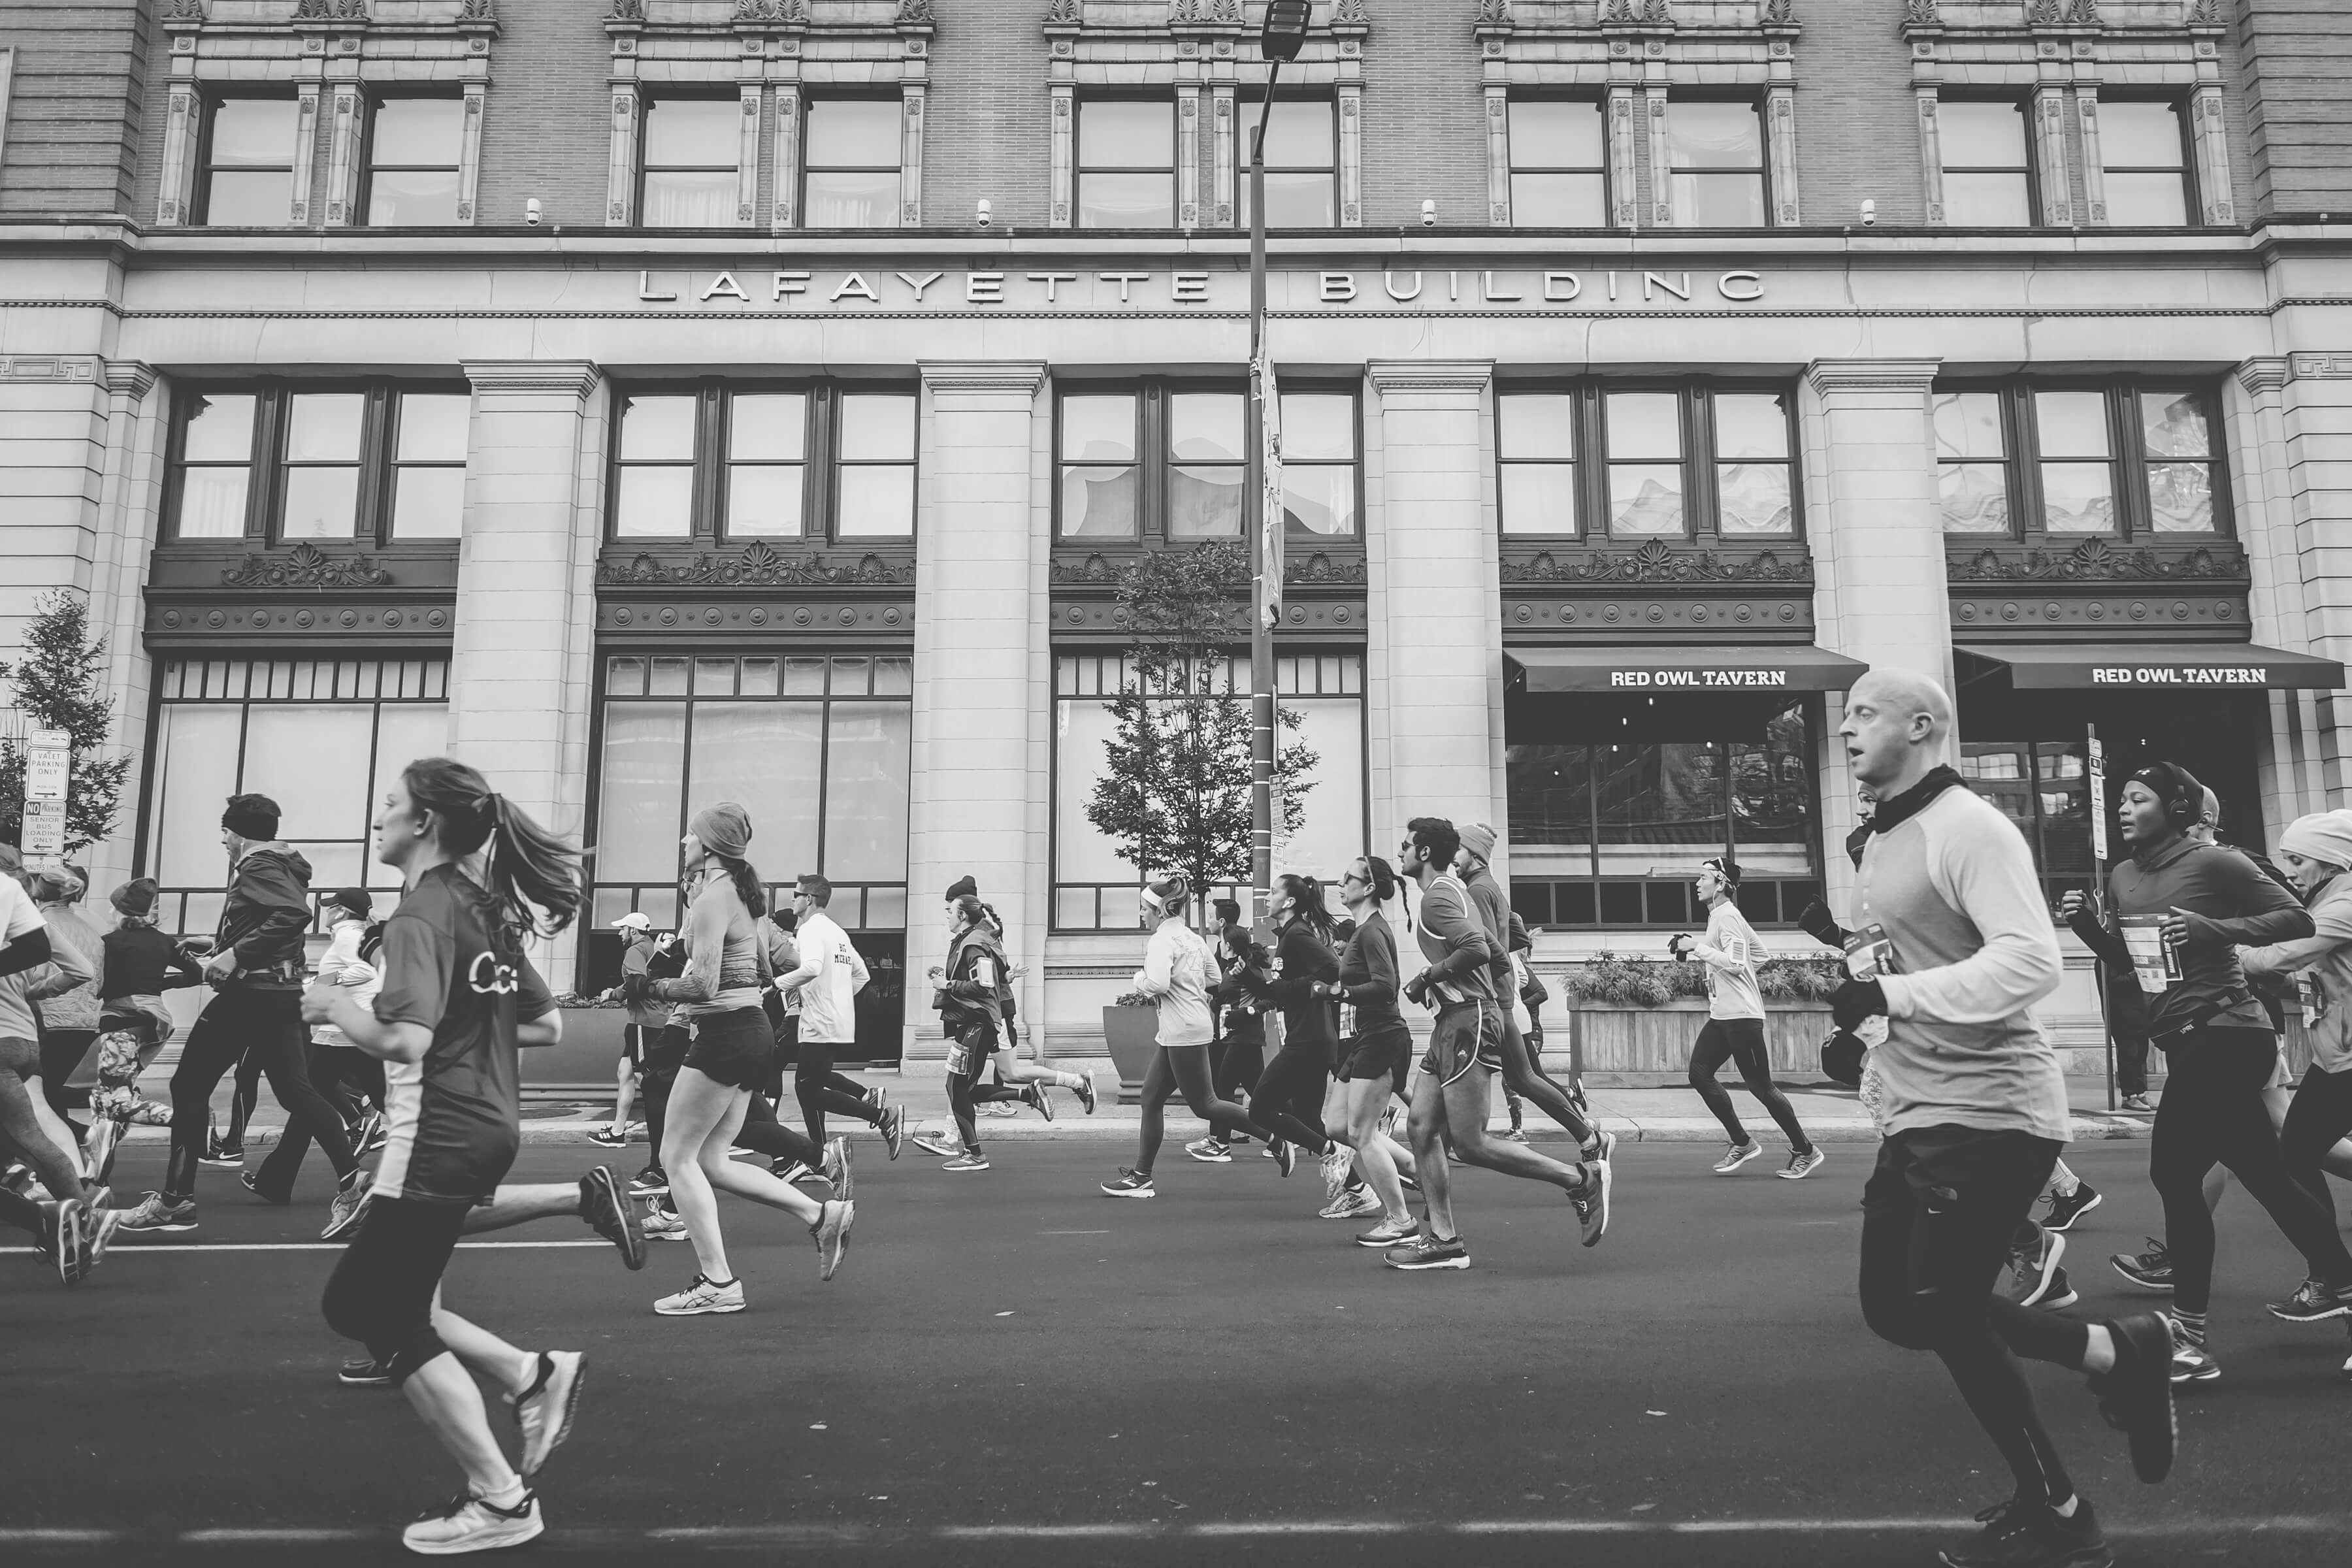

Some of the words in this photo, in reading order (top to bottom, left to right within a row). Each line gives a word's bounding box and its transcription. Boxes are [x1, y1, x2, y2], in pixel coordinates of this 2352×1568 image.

[639, 270, 1209, 302] LAFAYETTE
[1319, 270, 1765, 302] BUILDING
[1610, 671, 1651, 686] RED
[1654, 671, 1701, 686] OWL
[1702, 670, 1786, 685] TAVERN
[2092, 668, 2132, 683] RED
[2135, 668, 2182, 683] OWL
[2182, 668, 2266, 683] TAVERN
[31, 760, 67, 768] PARKING
[27, 803, 40, 815] NO
